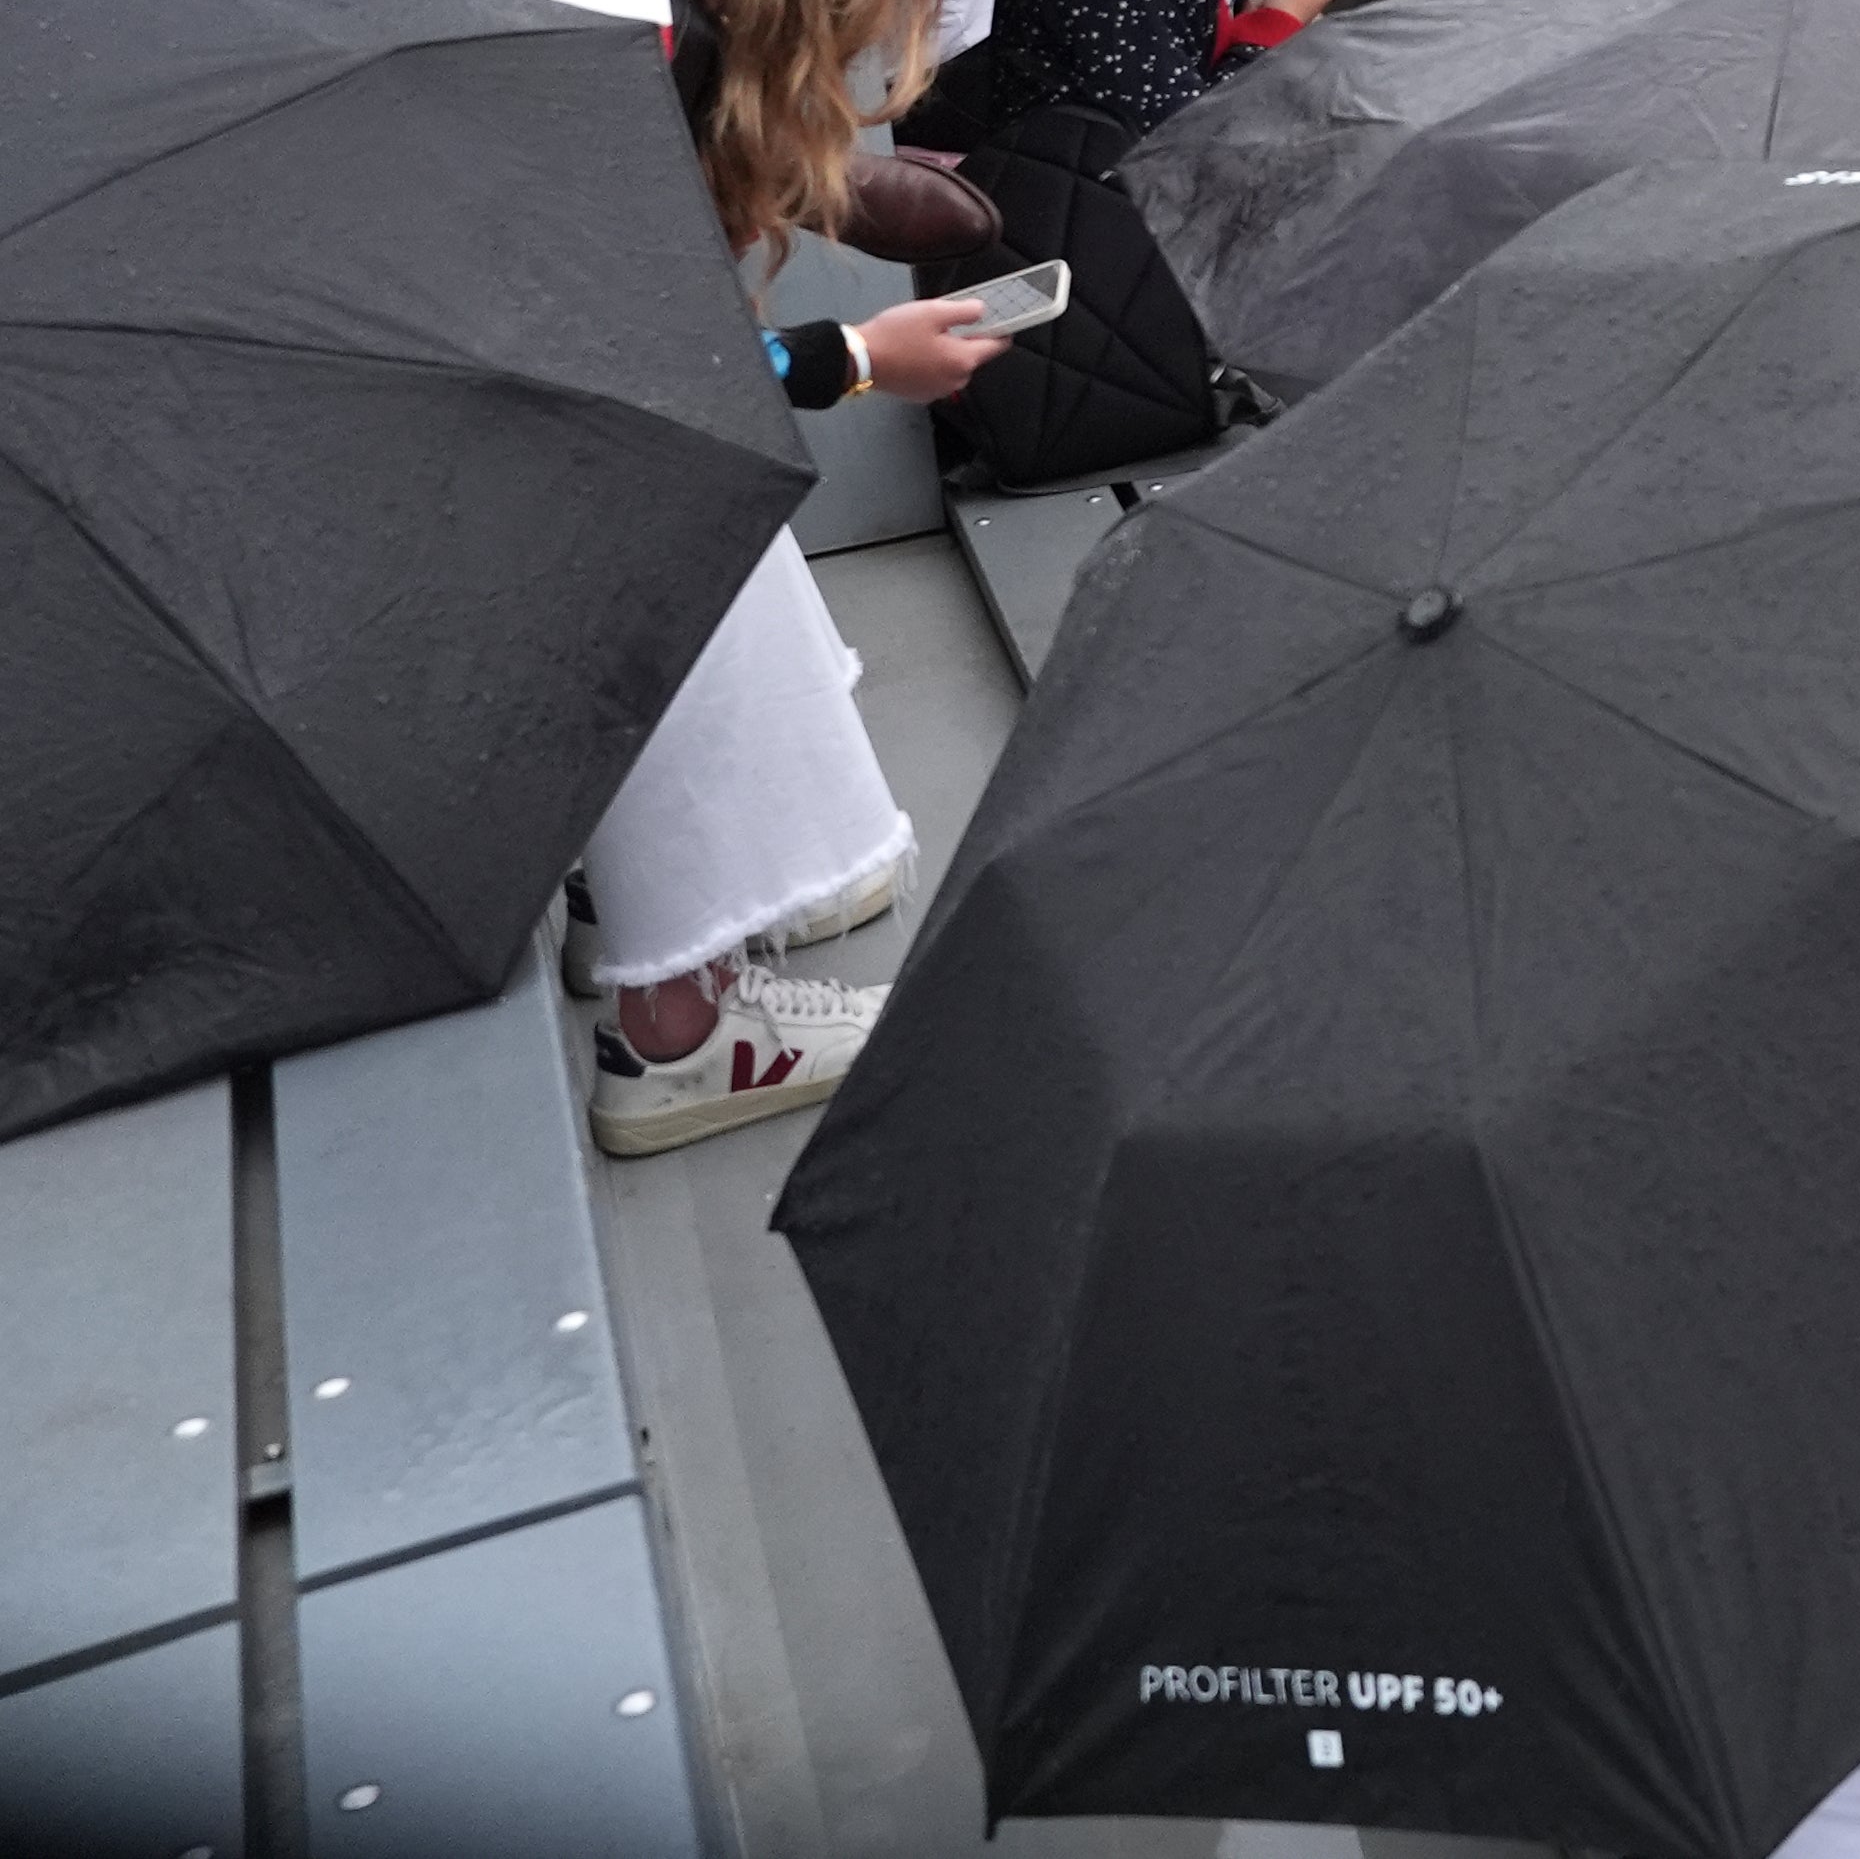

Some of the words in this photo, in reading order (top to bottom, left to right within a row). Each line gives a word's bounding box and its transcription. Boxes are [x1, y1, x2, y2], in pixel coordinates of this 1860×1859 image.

[1139, 1664, 1342, 1708] PROFILTER
[1347, 1671, 1425, 1713] UPF
[1433, 1676, 1504, 1717] 50+
